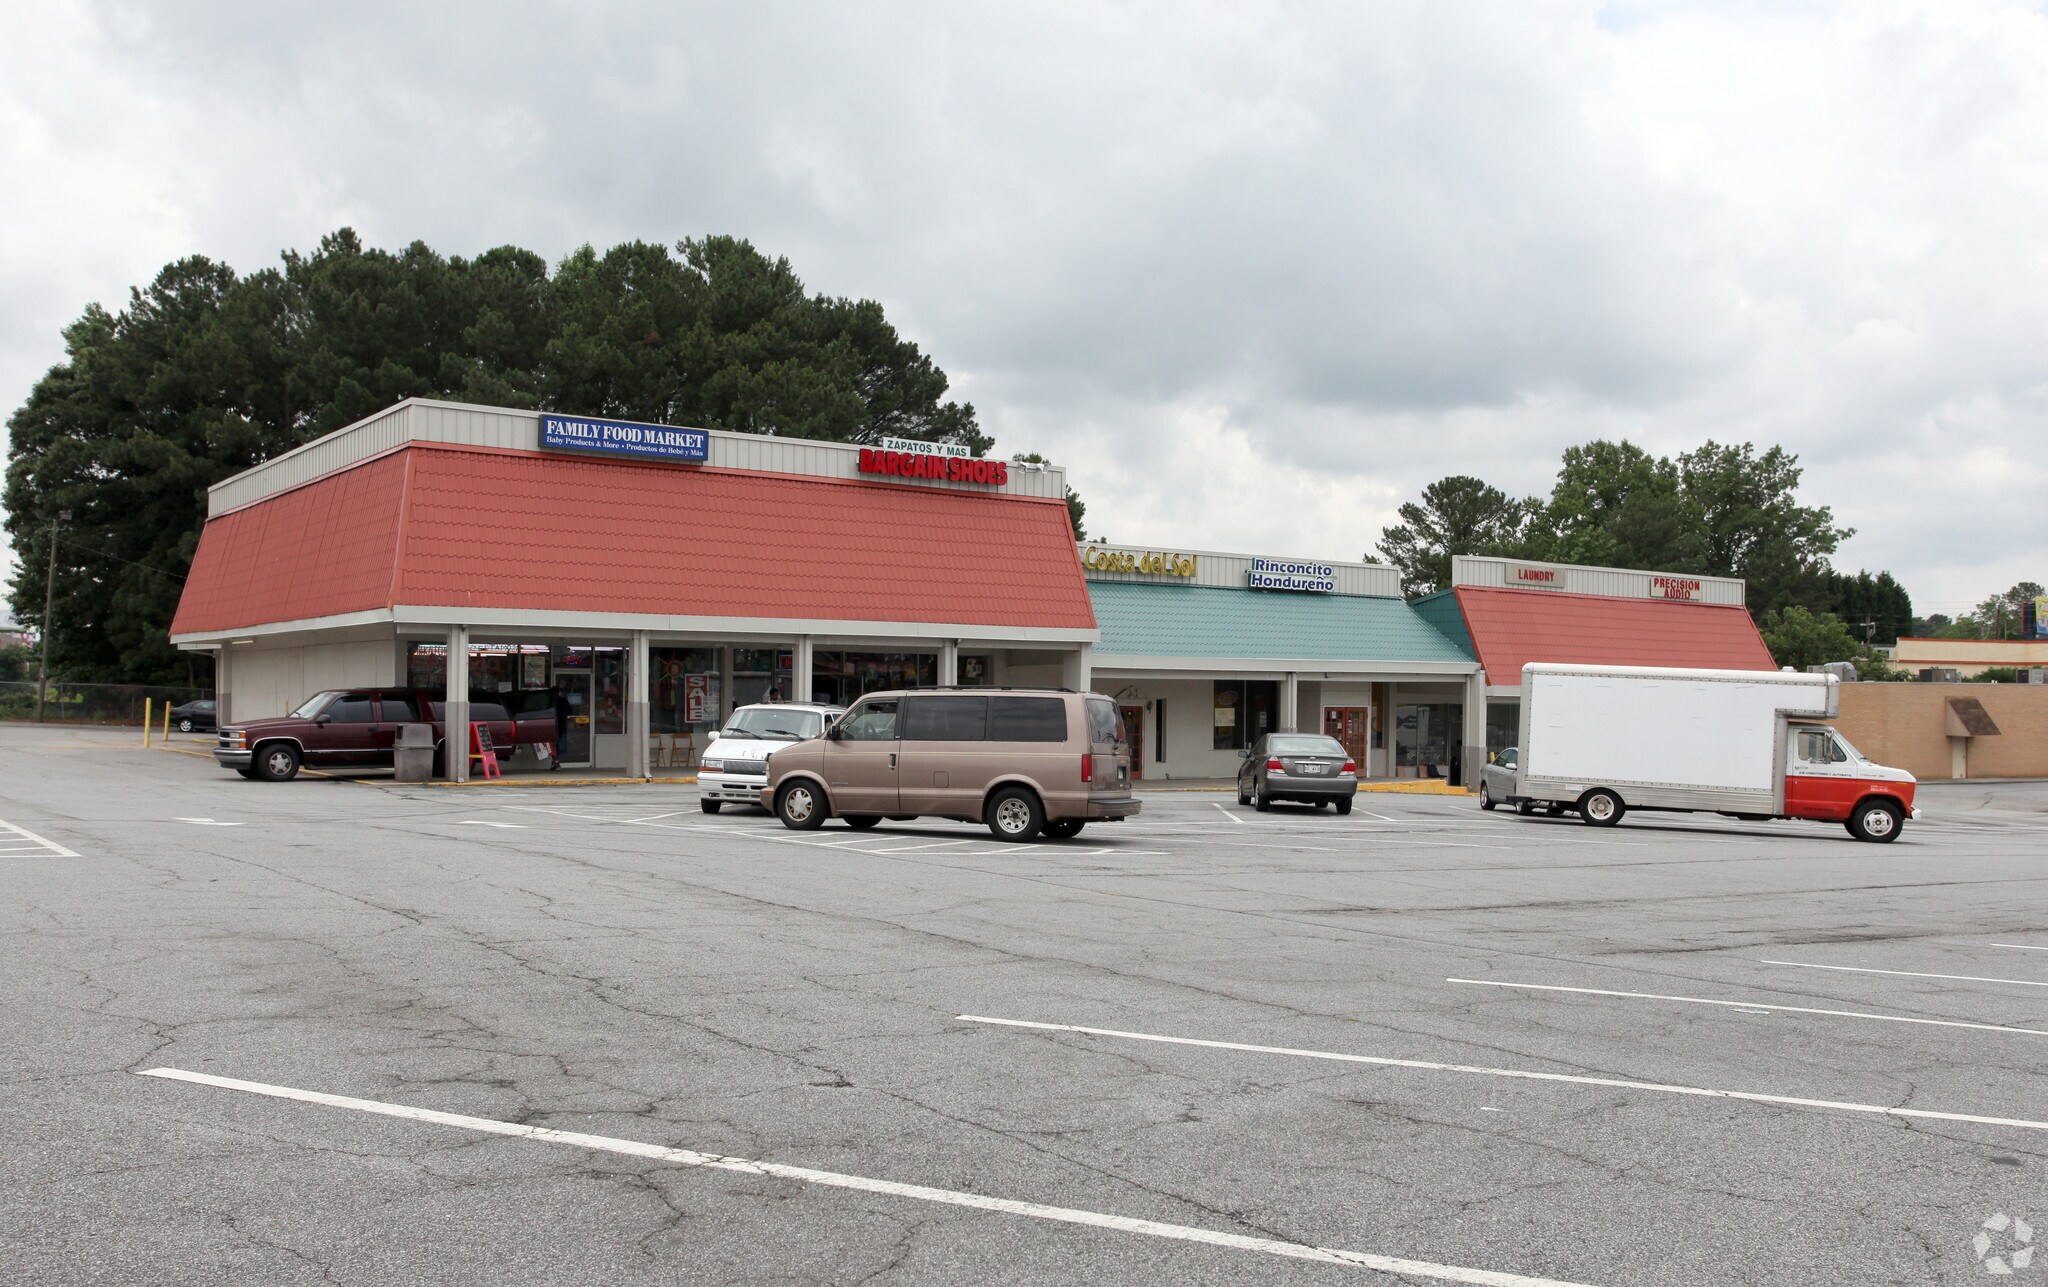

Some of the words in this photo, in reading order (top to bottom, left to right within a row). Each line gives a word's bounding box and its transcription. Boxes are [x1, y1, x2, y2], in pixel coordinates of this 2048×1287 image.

[546, 419, 601, 439] FAMILY
[602, 425, 642, 442] FOOD
[643, 429, 704, 448] MARKET
[546, 436, 564, 445] Baby
[565, 437, 595, 447] Products
[602, 441, 620, 449] More
[626, 443, 658, 453] Productos
[668, 447, 684, 455] Bebé
[690, 448, 704, 456] Más
[887, 439, 932, 454] ZAPATOS
[935, 445, 943, 454] Y
[946, 446, 967, 457] MAS
[859, 448, 947, 480] BARGAIN
[948, 457, 1008, 486] SHOES
[1084, 545, 1135, 573] Costa
[1140, 550, 1167, 575] del
[1170, 552, 1197, 577] Sol
[1255, 558, 1333, 576] Rinconcito
[1251, 573, 1334, 590] Hondureño
[1518, 568, 1555, 582] LAUNDRY
[1653, 577, 1700, 591] PRECISION
[1664, 588, 1691, 599] AUDIO
[688, 676, 705, 720] SALE
